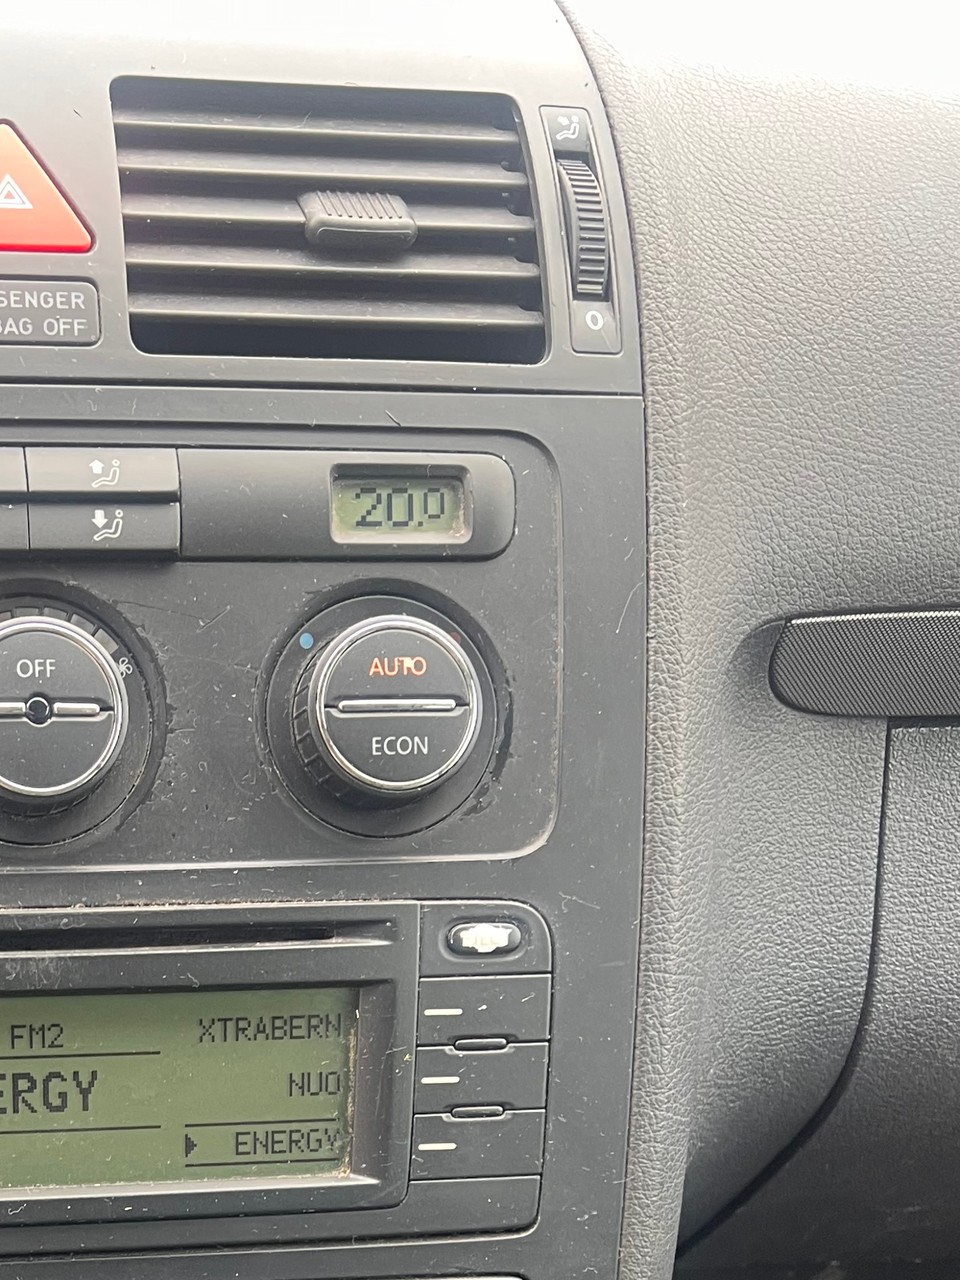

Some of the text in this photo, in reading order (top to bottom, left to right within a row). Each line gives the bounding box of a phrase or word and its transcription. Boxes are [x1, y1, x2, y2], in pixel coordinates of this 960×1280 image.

[43, 318, 87, 336] OFF
[16, 658, 56, 678] OFF
[369, 656, 427, 677] AUTO
[372, 736, 429, 756] ECON
[10, 1024, 64, 1050] FM2
[235, 1130, 339, 1156] ENERGY
